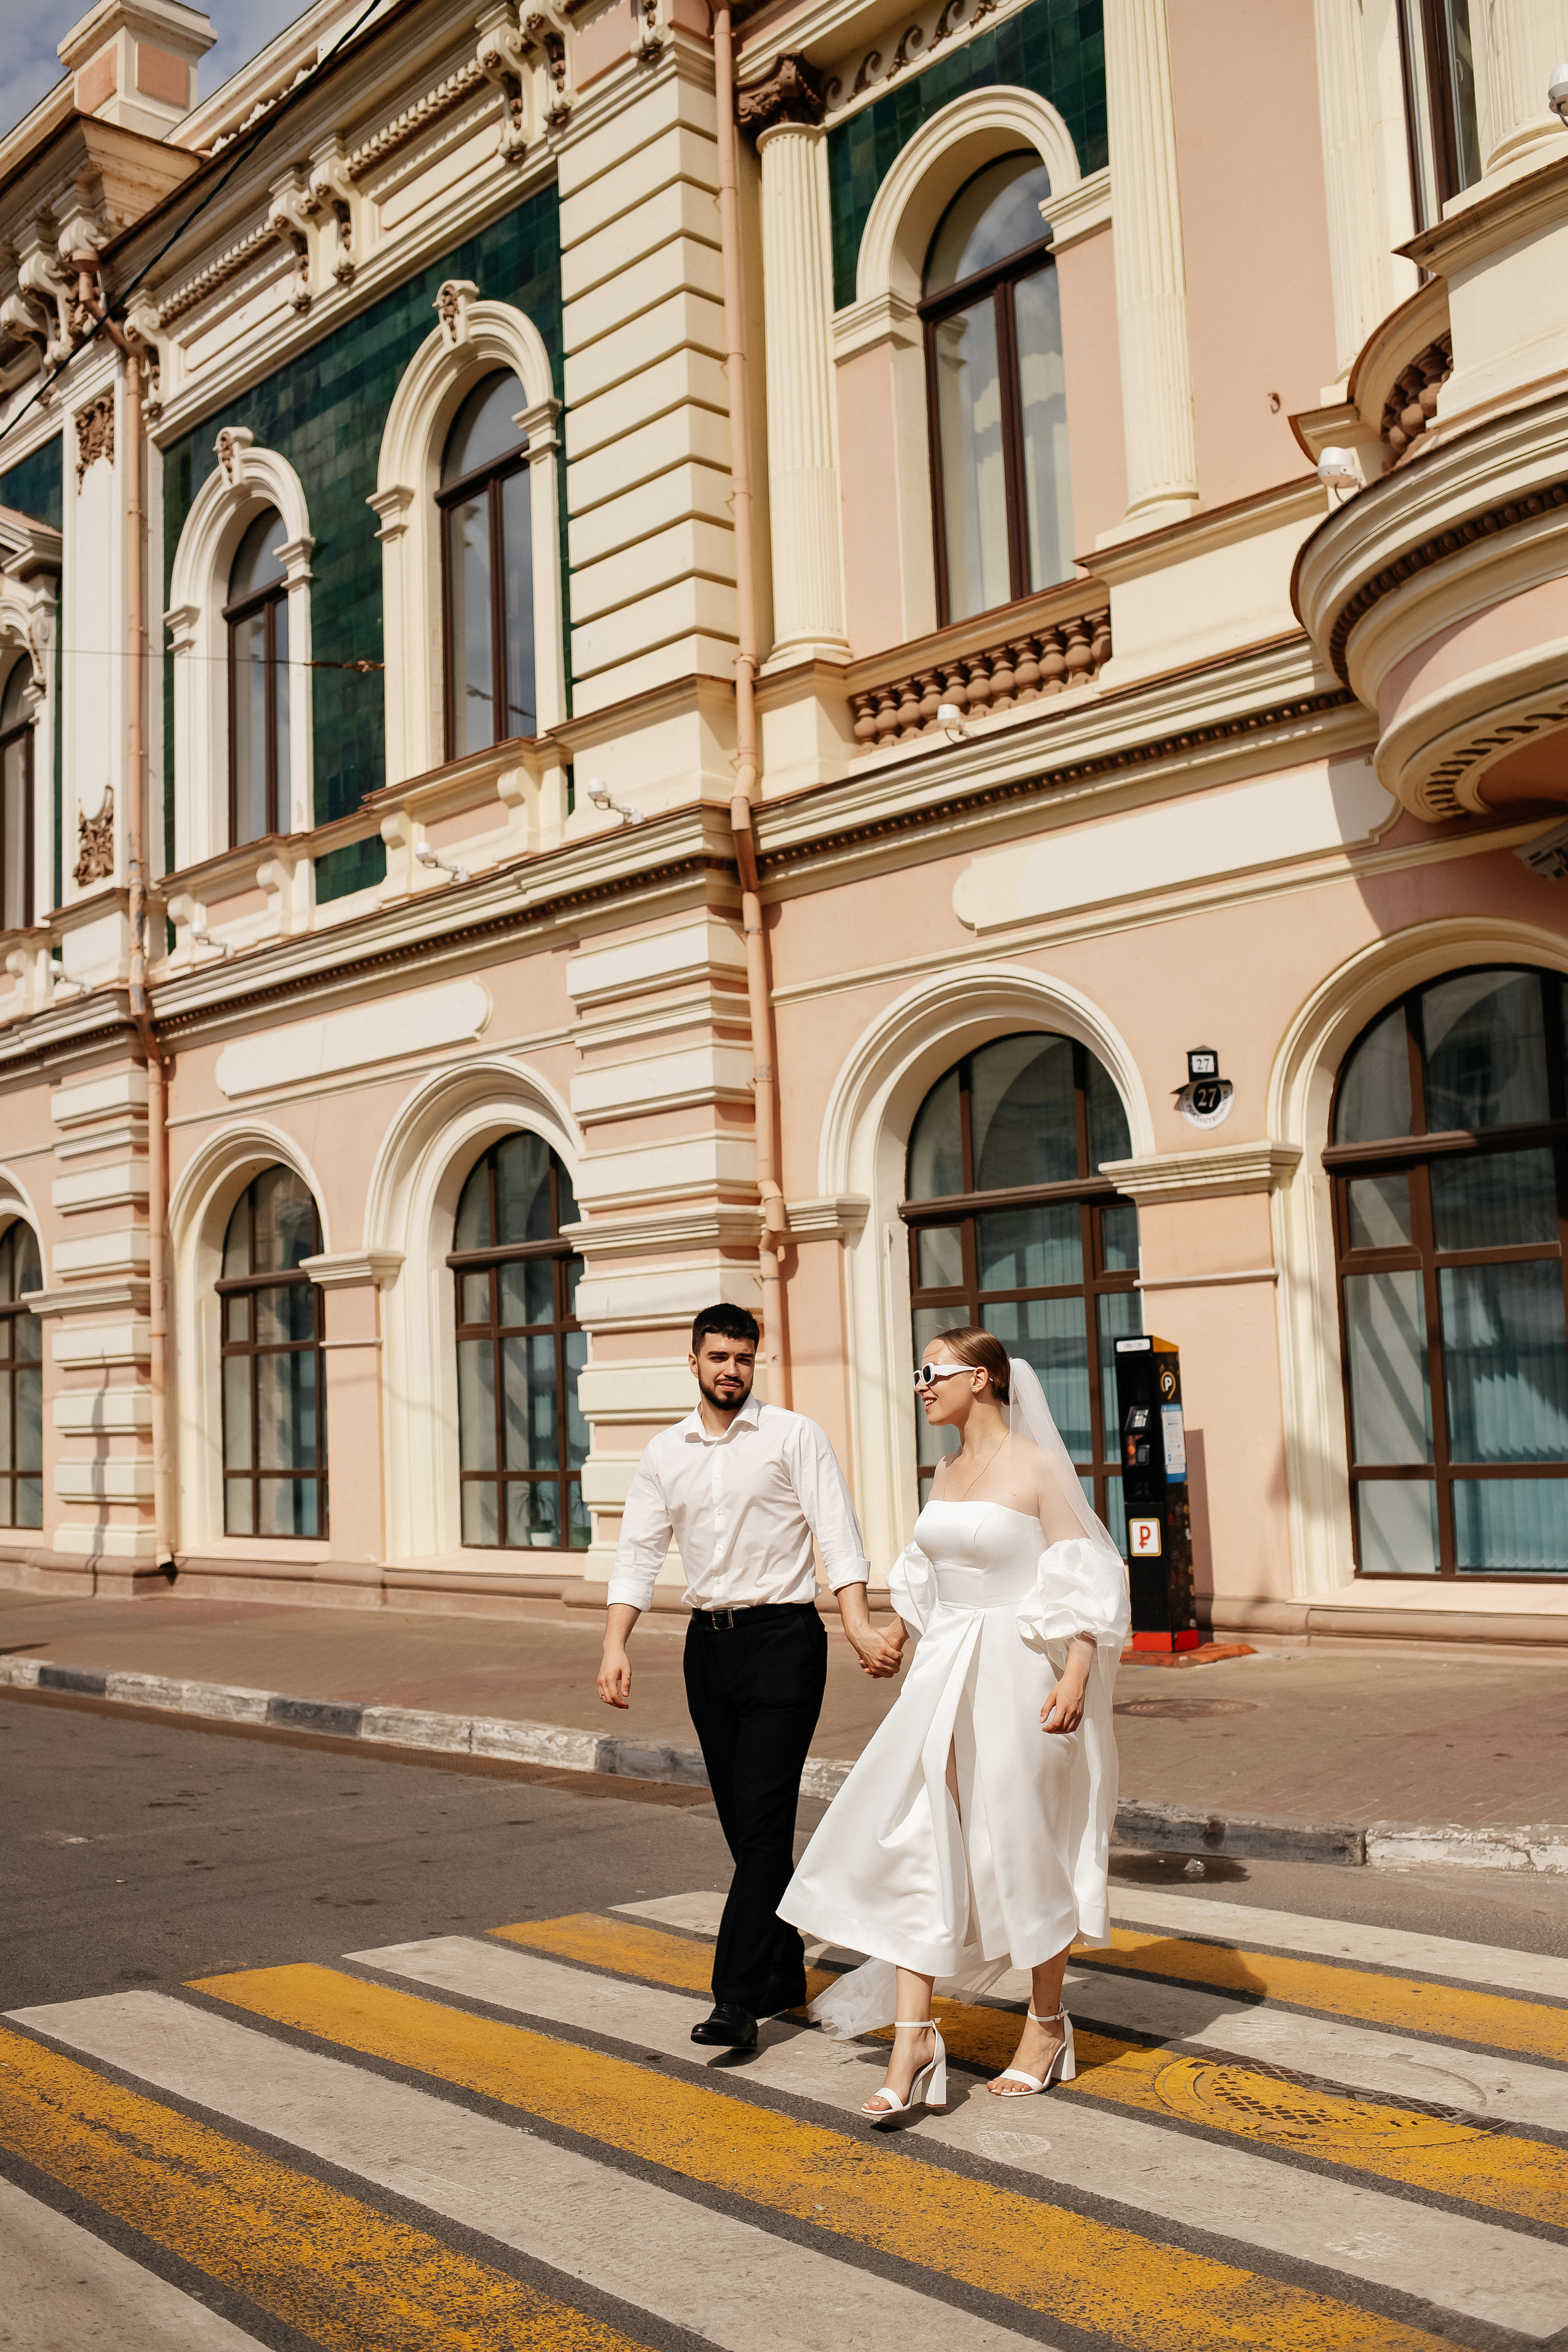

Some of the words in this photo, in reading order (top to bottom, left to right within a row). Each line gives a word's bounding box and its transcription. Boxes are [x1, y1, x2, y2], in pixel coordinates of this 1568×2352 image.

[1196, 1058, 1209, 1070] 27
[1197, 1088, 1217, 1107] 27
[1164, 1376, 1172, 1391] P
